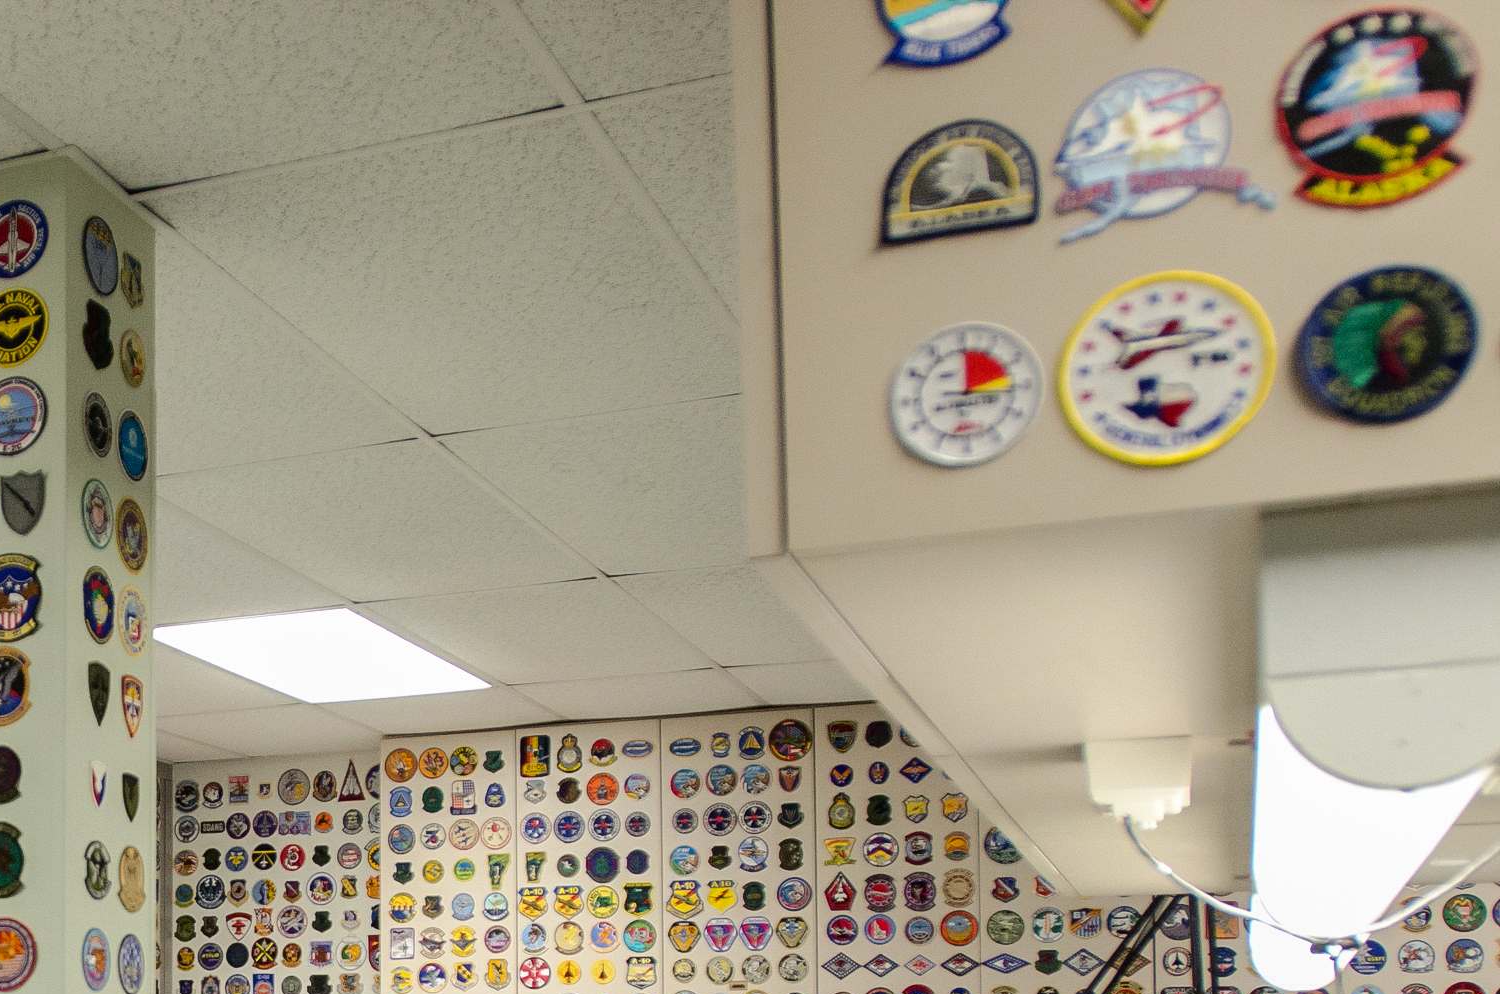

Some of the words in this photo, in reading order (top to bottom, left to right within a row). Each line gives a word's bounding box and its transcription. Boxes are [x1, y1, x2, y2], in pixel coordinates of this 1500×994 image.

[18, 204, 41, 224] SECTION
[5, 292, 42, 315] NAVAL
[673, 881, 696, 890] A-10
[523, 888, 544, 897] A-10
[558, 887, 579, 896] A-10
